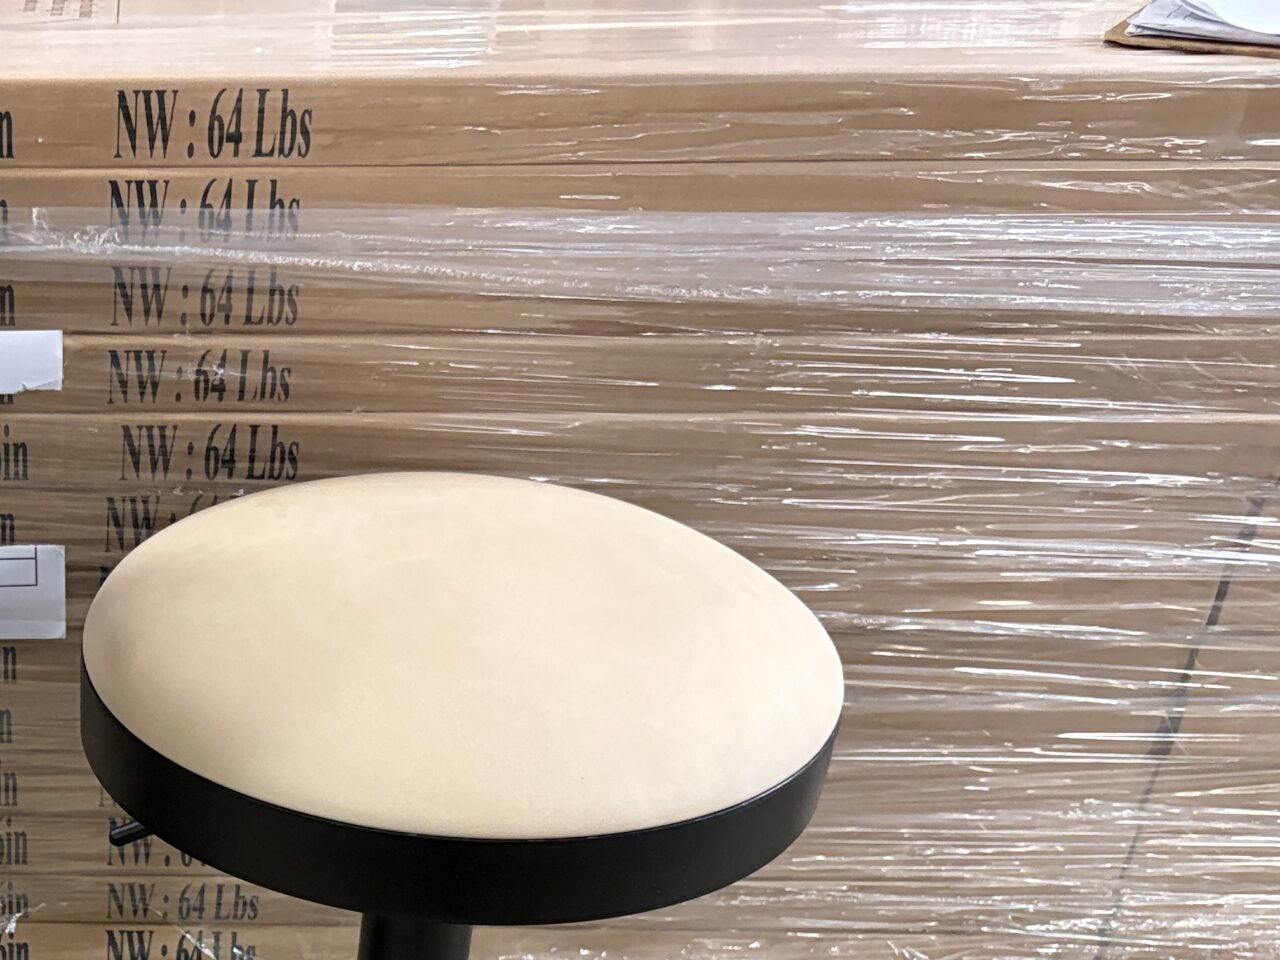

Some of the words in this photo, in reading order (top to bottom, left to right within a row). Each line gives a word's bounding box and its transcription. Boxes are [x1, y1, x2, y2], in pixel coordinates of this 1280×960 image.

[207, 88, 244, 159] 64
[252, 88, 313, 159] Lbs
[198, 178, 233, 243] 64
[199, 267, 234, 327] 64
[243, 266, 300, 326] Lbs
[194, 349, 227, 402] 64
[236, 349, 292, 402] Lbs
[204, 423, 237, 481] 64
[245, 424, 300, 481] Lbs
[178, 882, 207, 920] 64
[213, 883, 260, 921] Lbs
